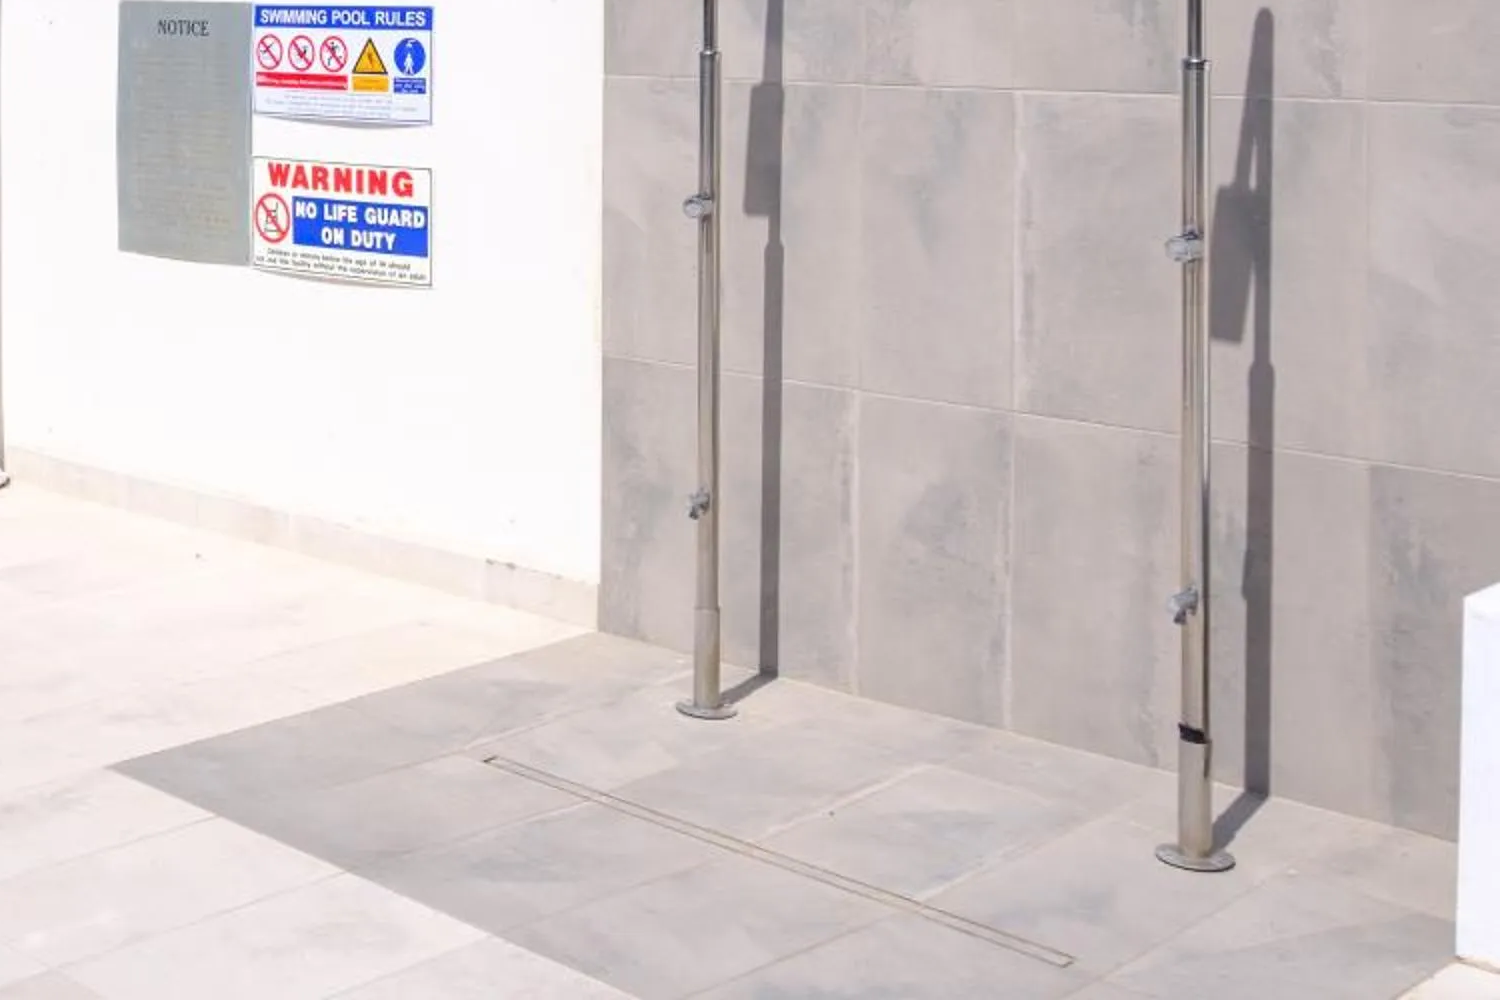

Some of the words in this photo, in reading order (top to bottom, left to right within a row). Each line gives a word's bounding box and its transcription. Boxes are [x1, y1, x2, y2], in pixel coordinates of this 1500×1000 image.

[157, 19, 210, 36] NOTICE
[260, 8, 328, 25] SWIMMING
[331, 9, 370, 25] POOL
[375, 11, 426, 27] RULES
[268, 161, 414, 198] WARNING
[295, 201, 317, 219] NO
[323, 203, 358, 223] LIFE
[364, 207, 425, 229] GUARD
[321, 227, 345, 245] ON
[350, 230, 396, 250] DUTY
